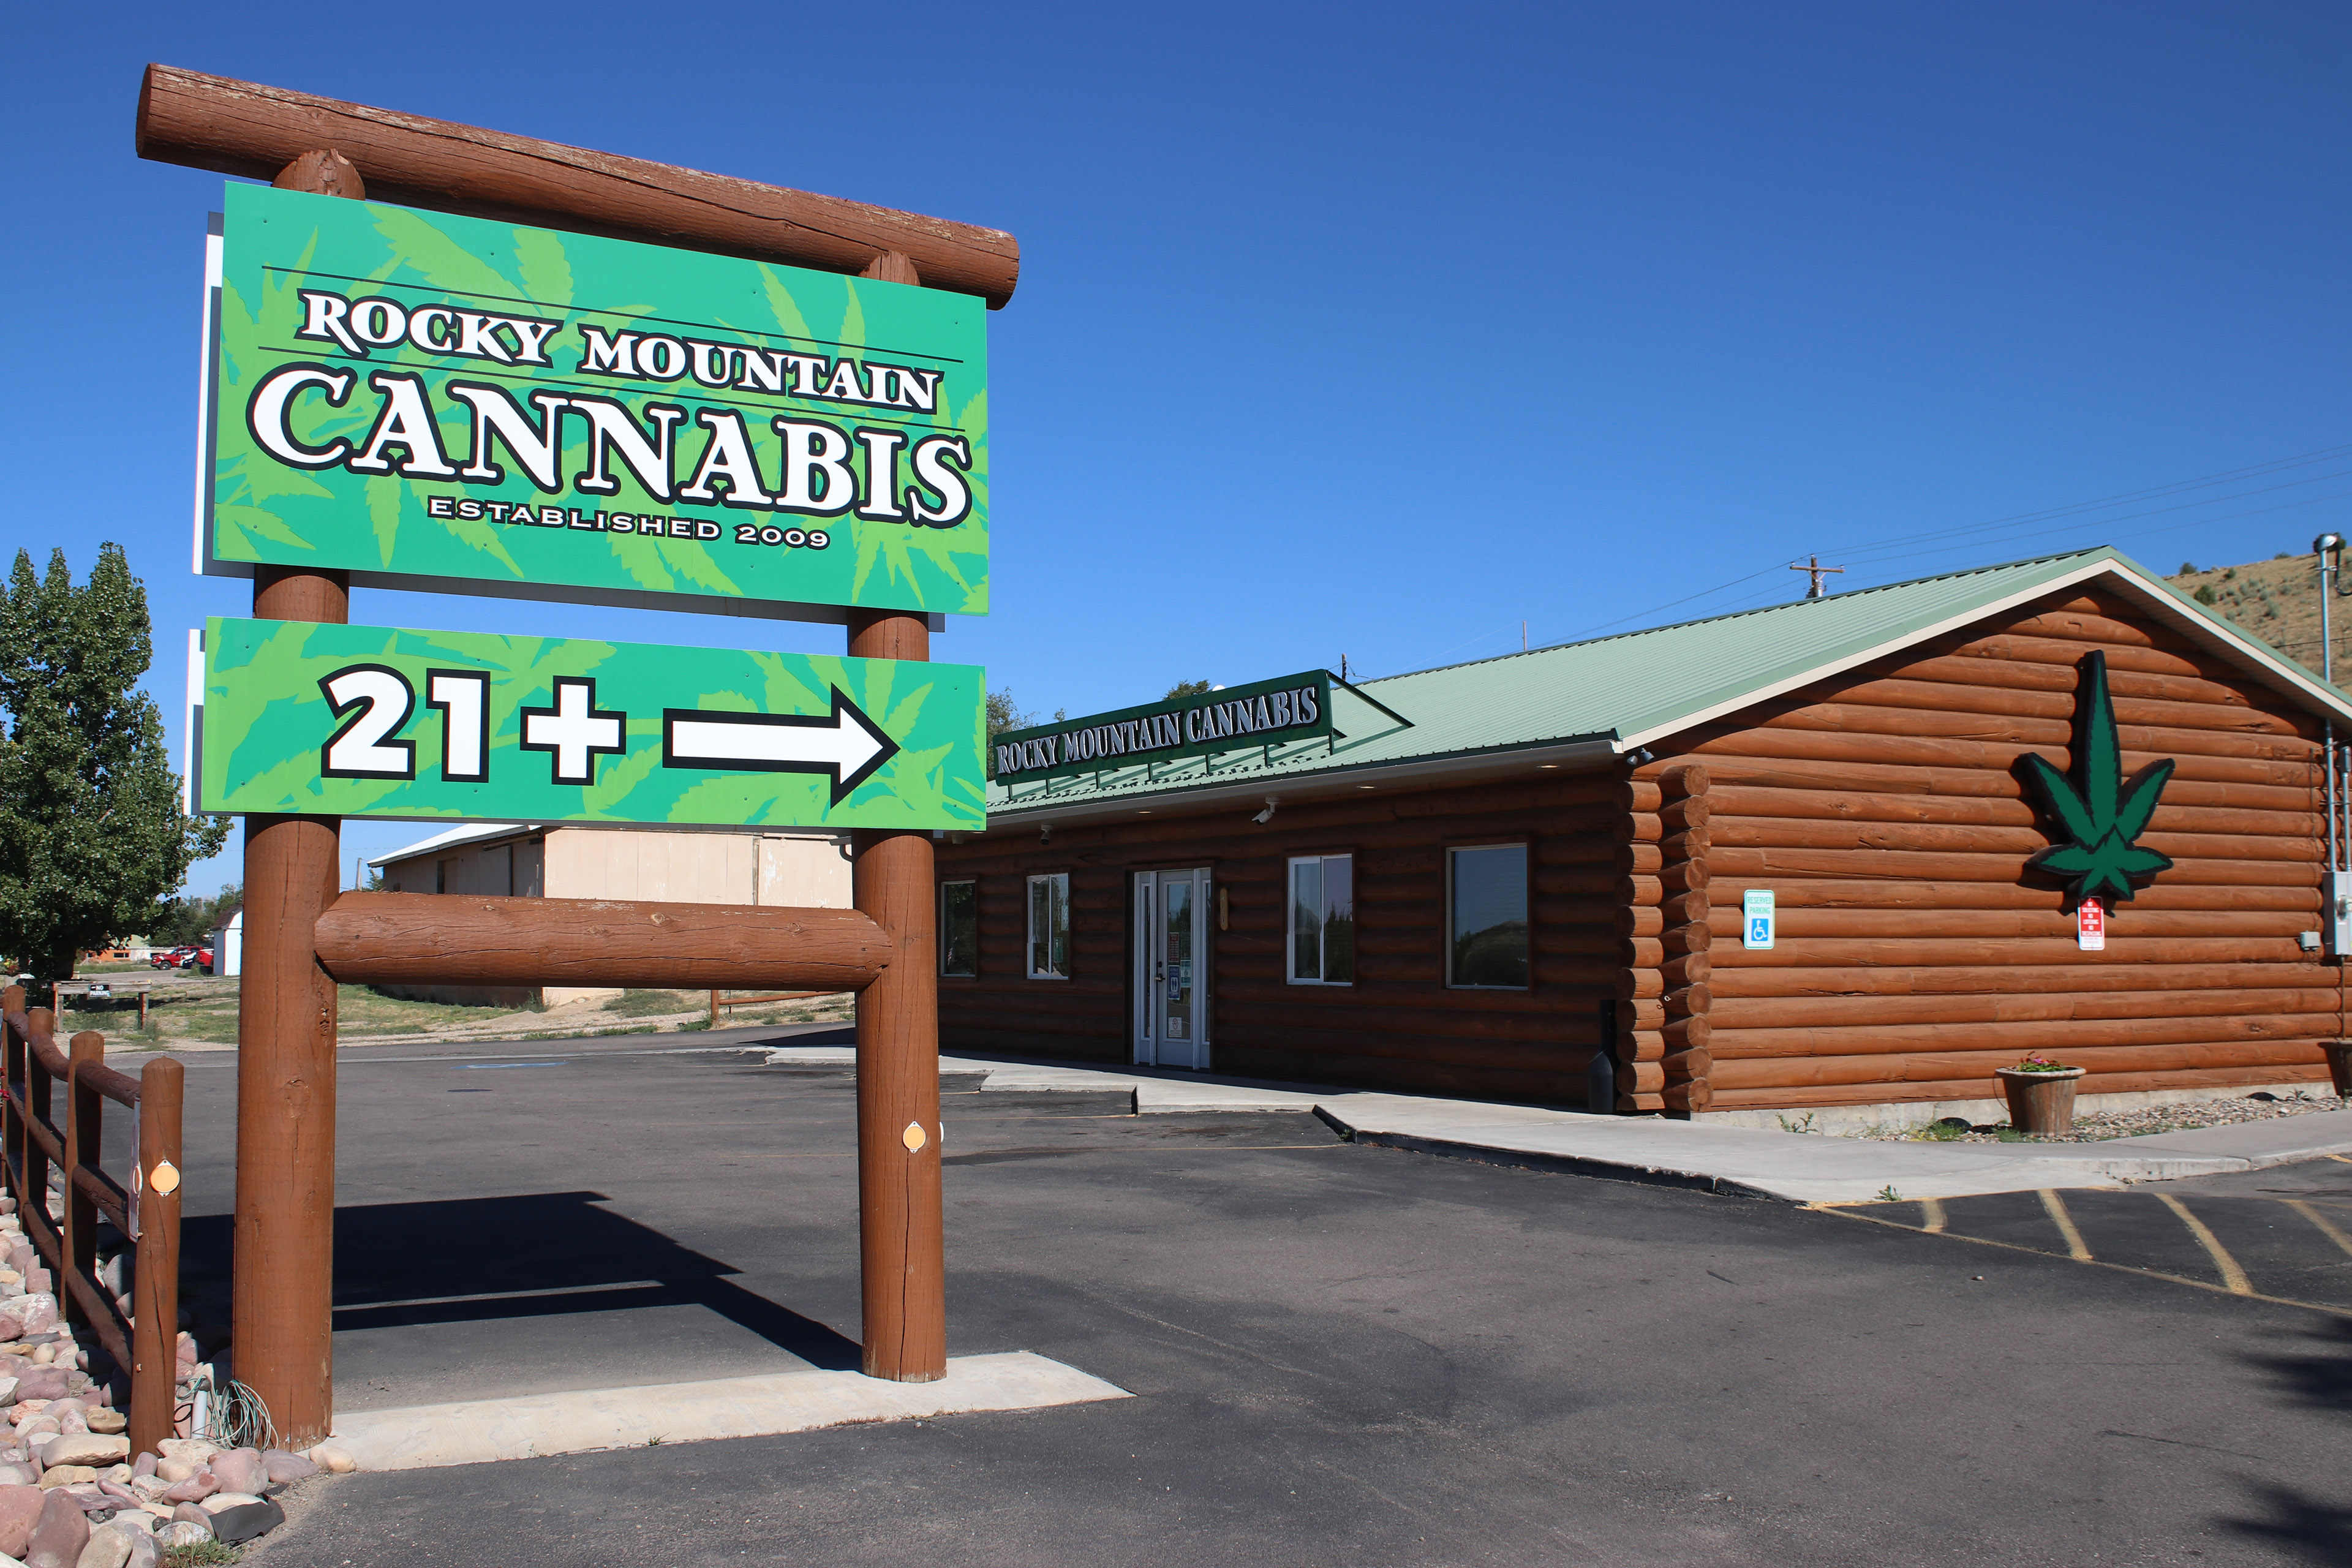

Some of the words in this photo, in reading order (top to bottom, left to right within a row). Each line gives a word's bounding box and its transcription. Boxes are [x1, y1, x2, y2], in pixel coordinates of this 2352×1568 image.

[300, 292, 558, 364] ROCKY
[579, 328, 940, 411] MOUNTAIN
[252, 368, 968, 523] CANNABIS
[429, 498, 723, 539] ESTABLISHED
[737, 526, 829, 552] 2009
[321, 666, 624, 781] 21+
[995, 735, 1058, 774] ROCKY
[1062, 712, 1181, 763] MOUNTAIN
[1186, 687, 1317, 743] CANNABIS
